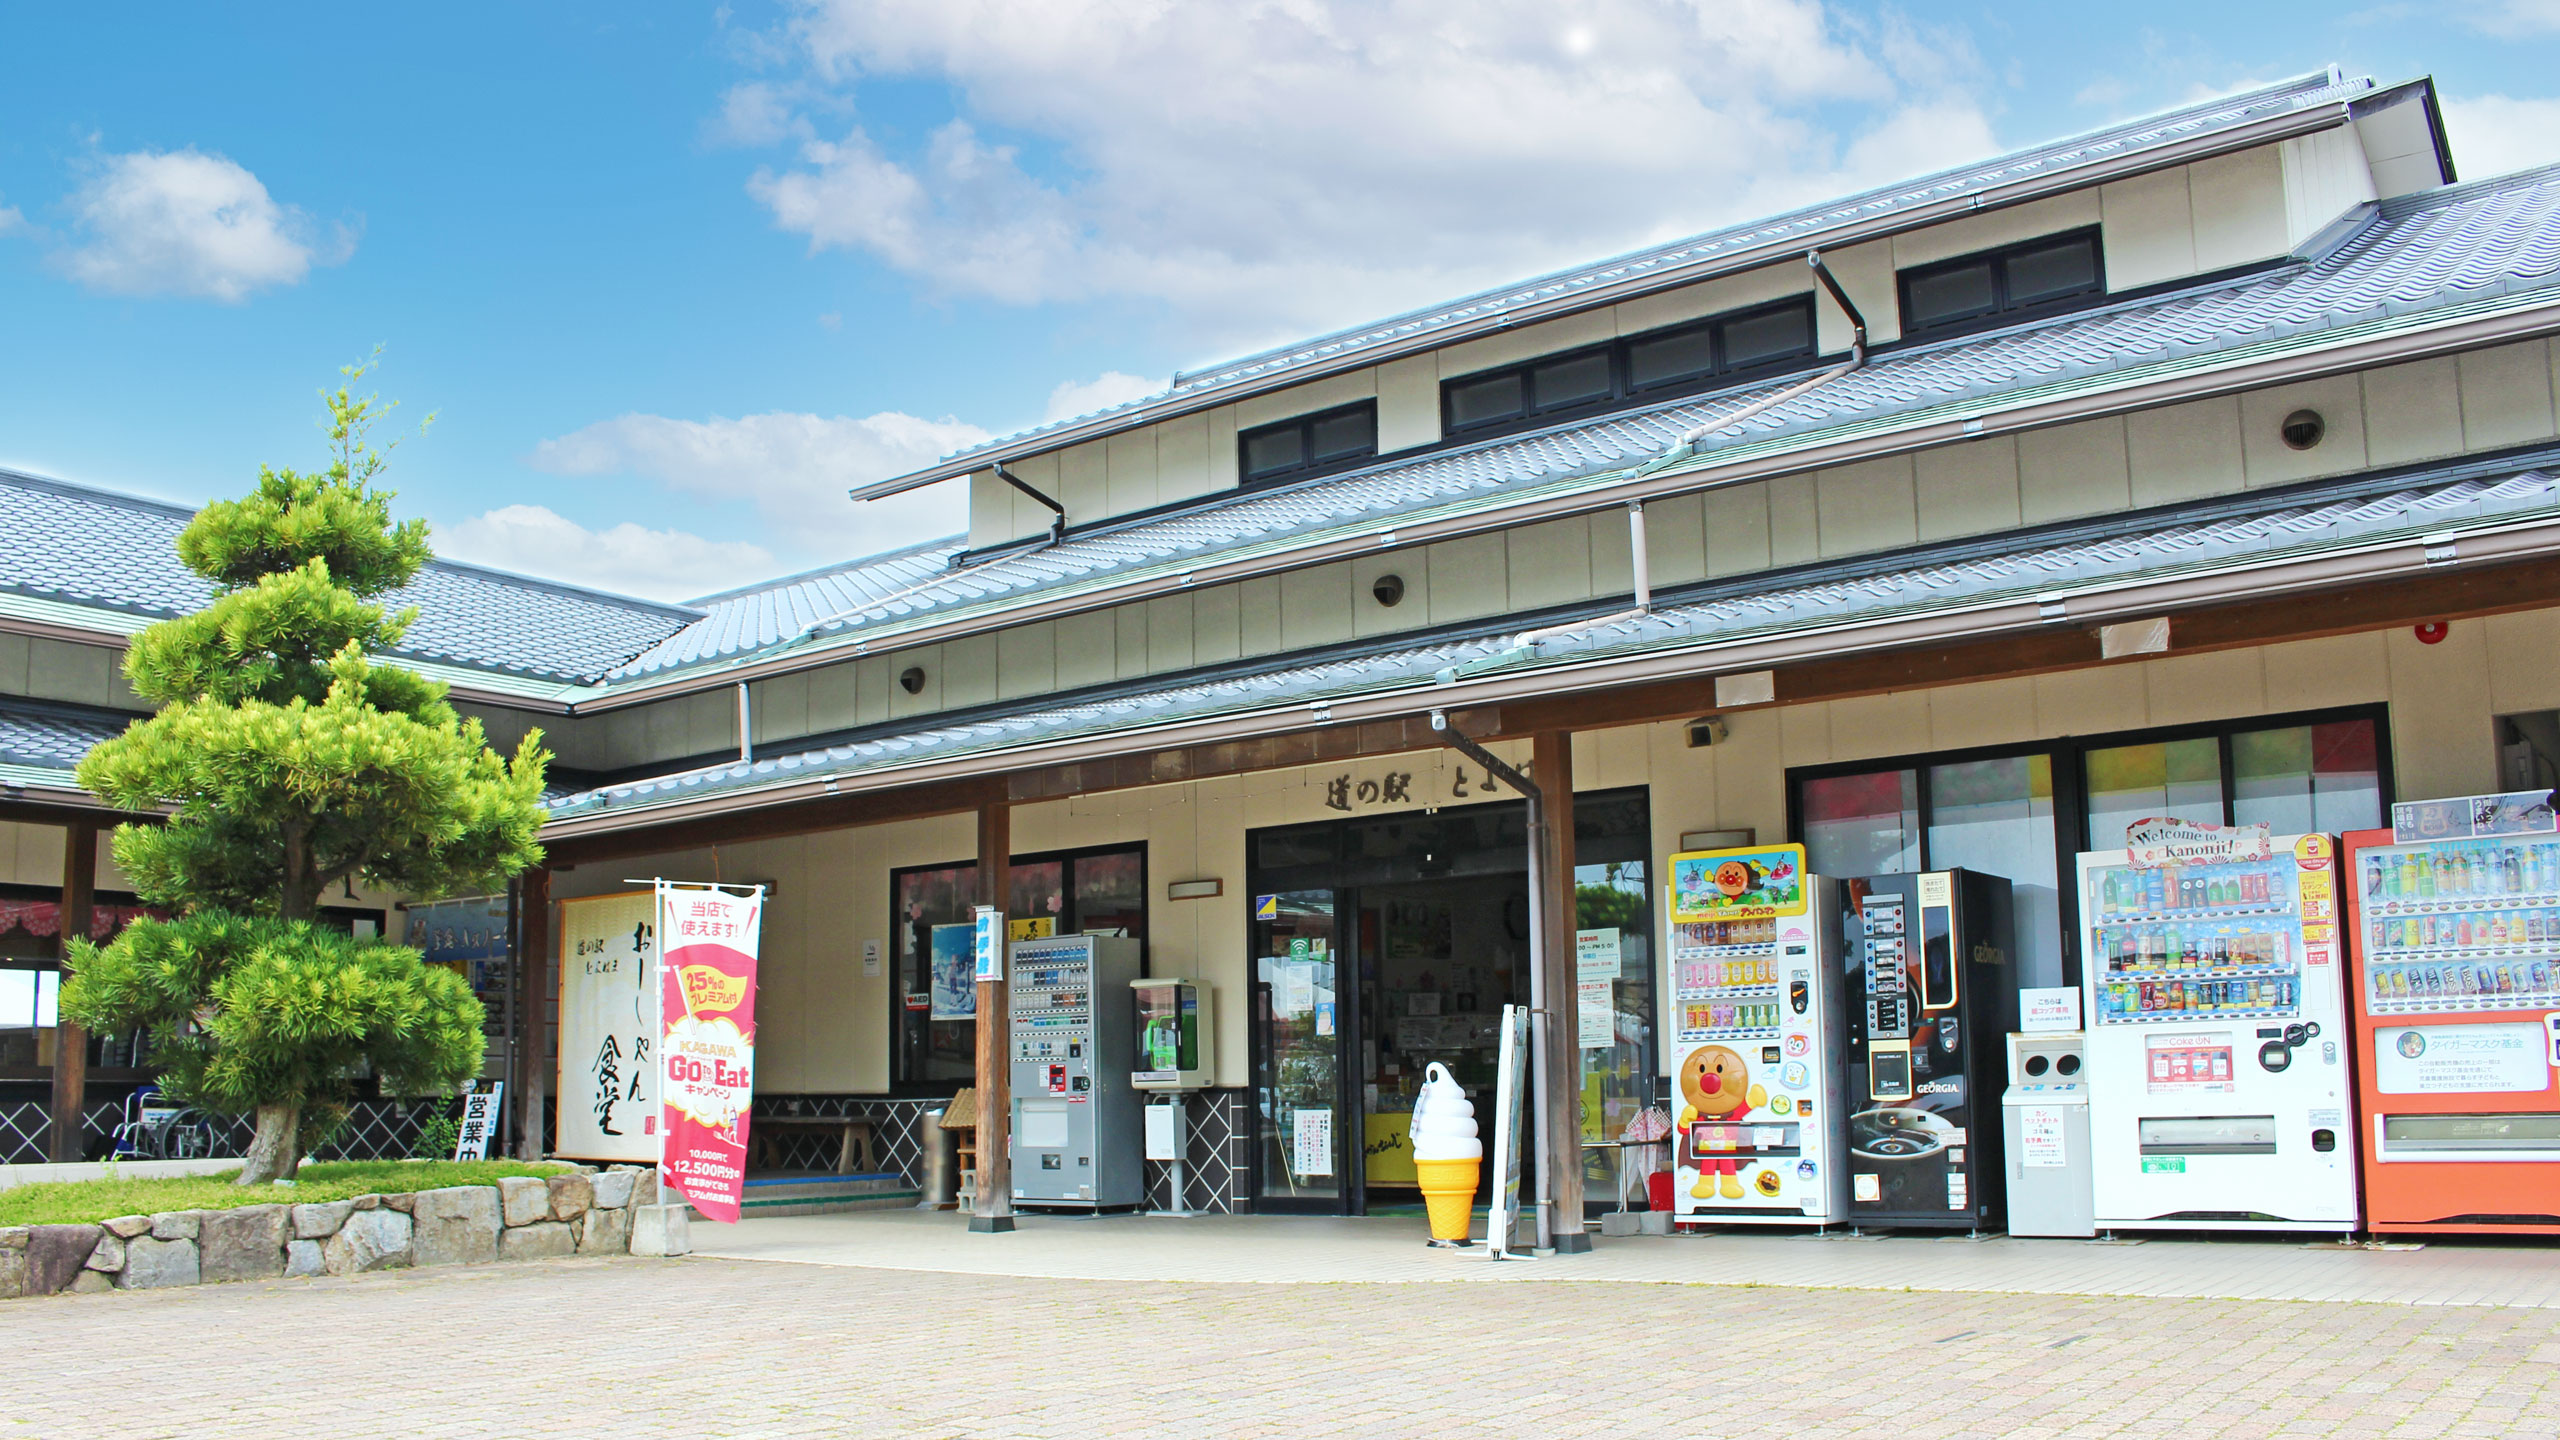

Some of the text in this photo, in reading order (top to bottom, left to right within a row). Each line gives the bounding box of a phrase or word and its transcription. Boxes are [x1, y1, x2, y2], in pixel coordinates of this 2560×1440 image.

[1325, 772, 1411, 811] 道の駅
[2136, 829, 2217, 845] Welcome to
[2166, 840, 2234, 857] Kanonji!
[690, 901, 734, 917] 当店で
[681, 920, 738, 938] 使えます!
[2445, 970, 2457, 992] BOSS
[2463, 969, 2476, 991] BOSS
[691, 991, 737, 1006] プレミアム付
[913, 995, 928, 1003] AED
[680, 1041, 736, 1057] KAGAWA
[2169, 1036, 2211, 1046] Coke ON
[2431, 1039, 2524, 1050] タイガーマスク基金
[715, 1059, 749, 1088] Eat
[592, 1035, 623, 1135] 食堂
[685, 1084, 731, 1100] キャンペーン
[1917, 1081, 1957, 1093] GEORGIA
